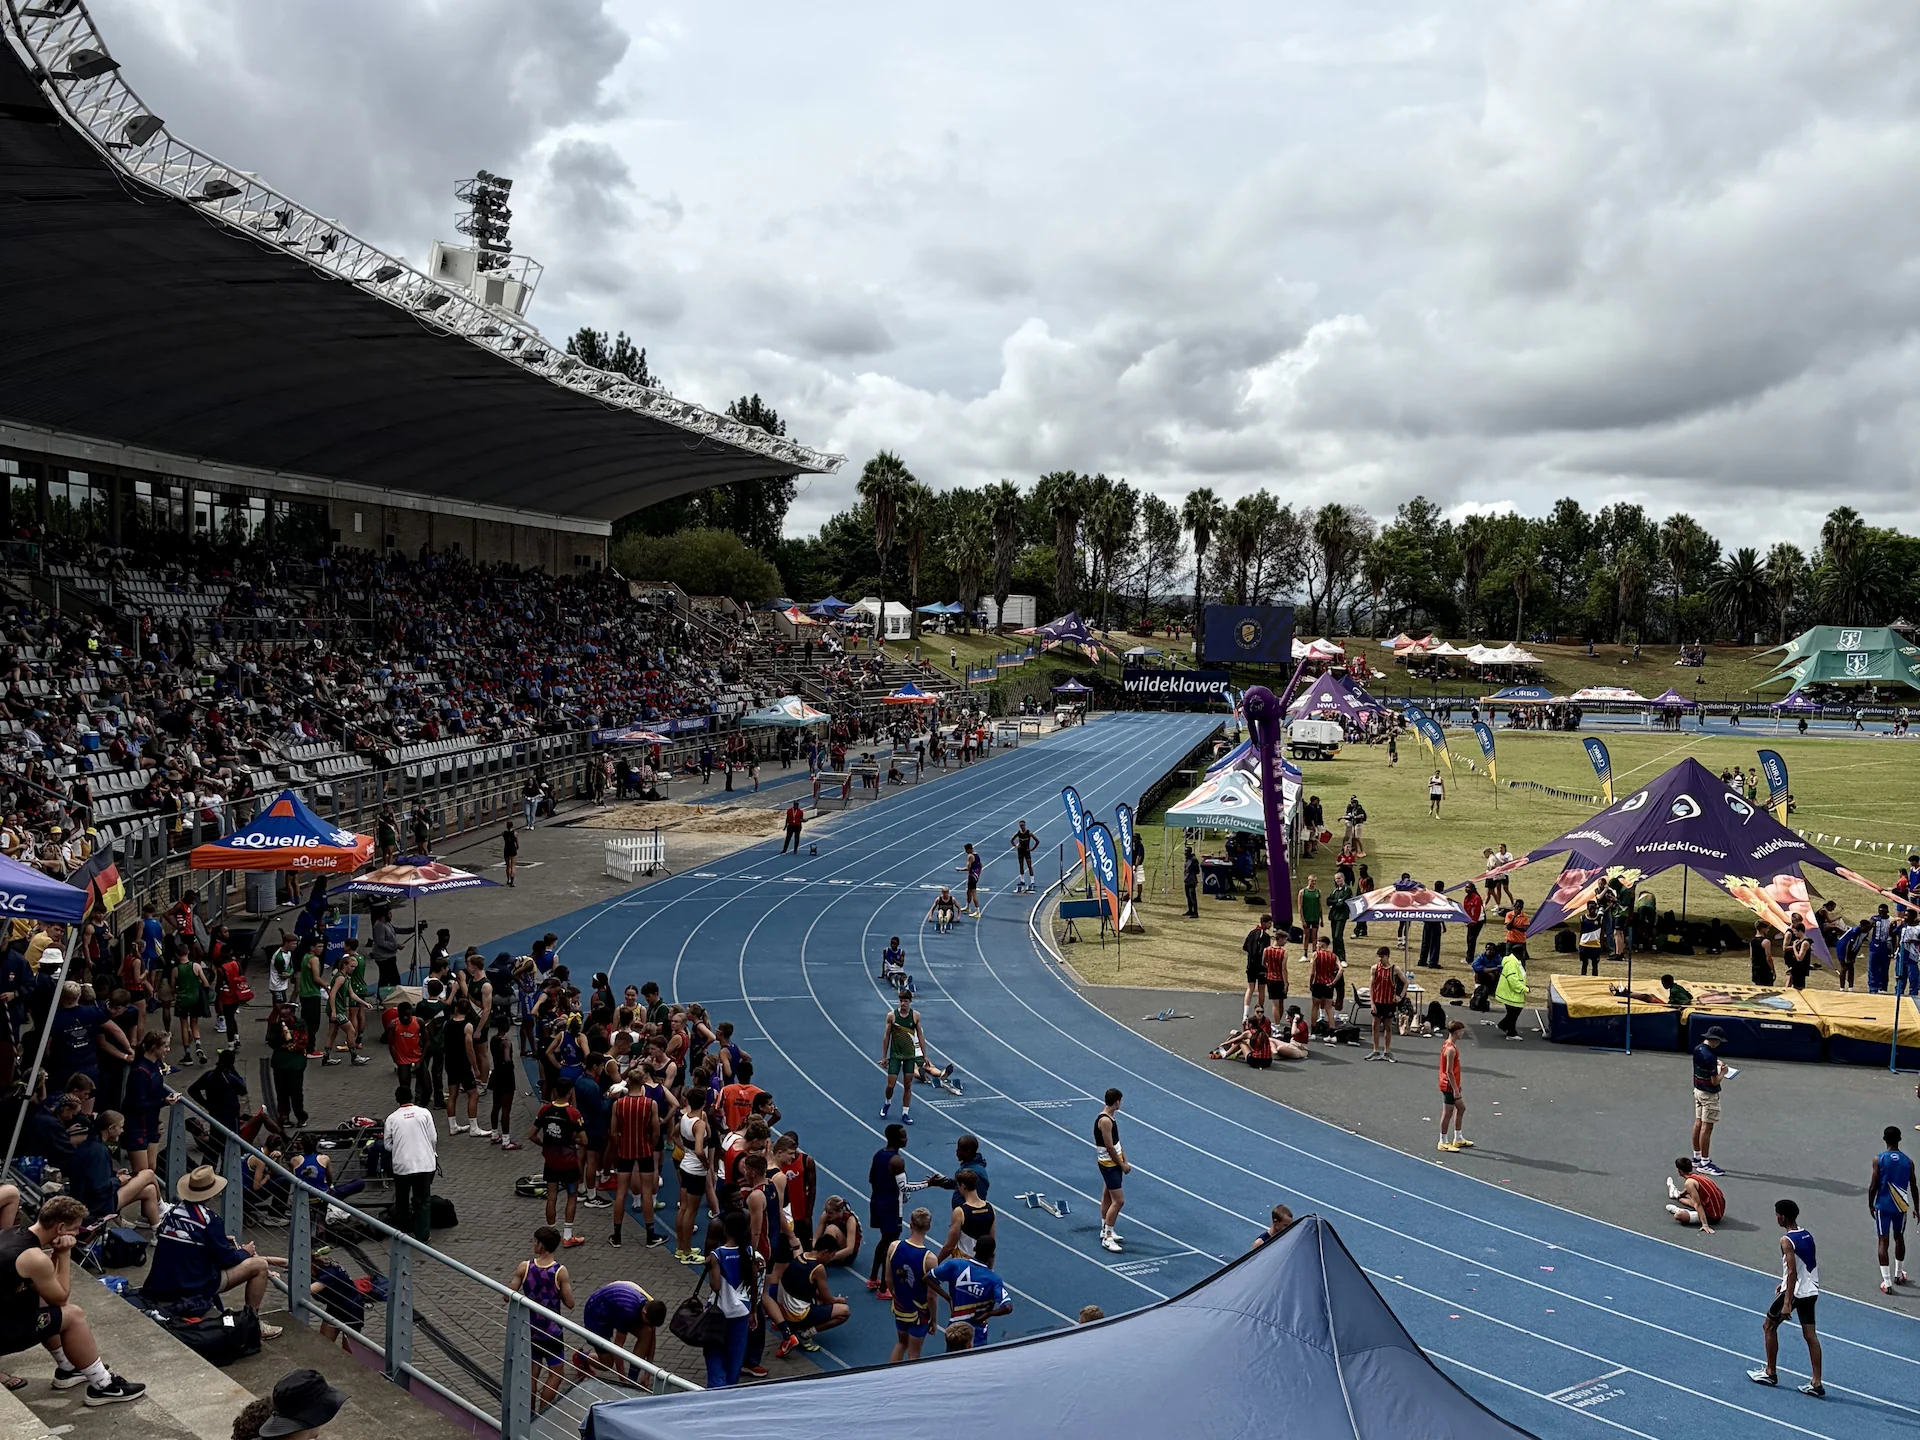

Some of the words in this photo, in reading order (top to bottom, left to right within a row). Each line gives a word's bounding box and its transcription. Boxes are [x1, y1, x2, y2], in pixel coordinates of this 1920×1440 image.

[1123, 675, 1228, 693] wildeklawer
[1509, 690, 1540, 698] CURRO
[1196, 815, 1260, 830] wildeklawer
[230, 832, 320, 849] aQuellé
[1635, 841, 1727, 860] wildeklawer
[292, 855, 338, 868] aQuellé
[429, 879, 482, 893] wildeklawer
[1385, 911, 1454, 919] wildeklawer
